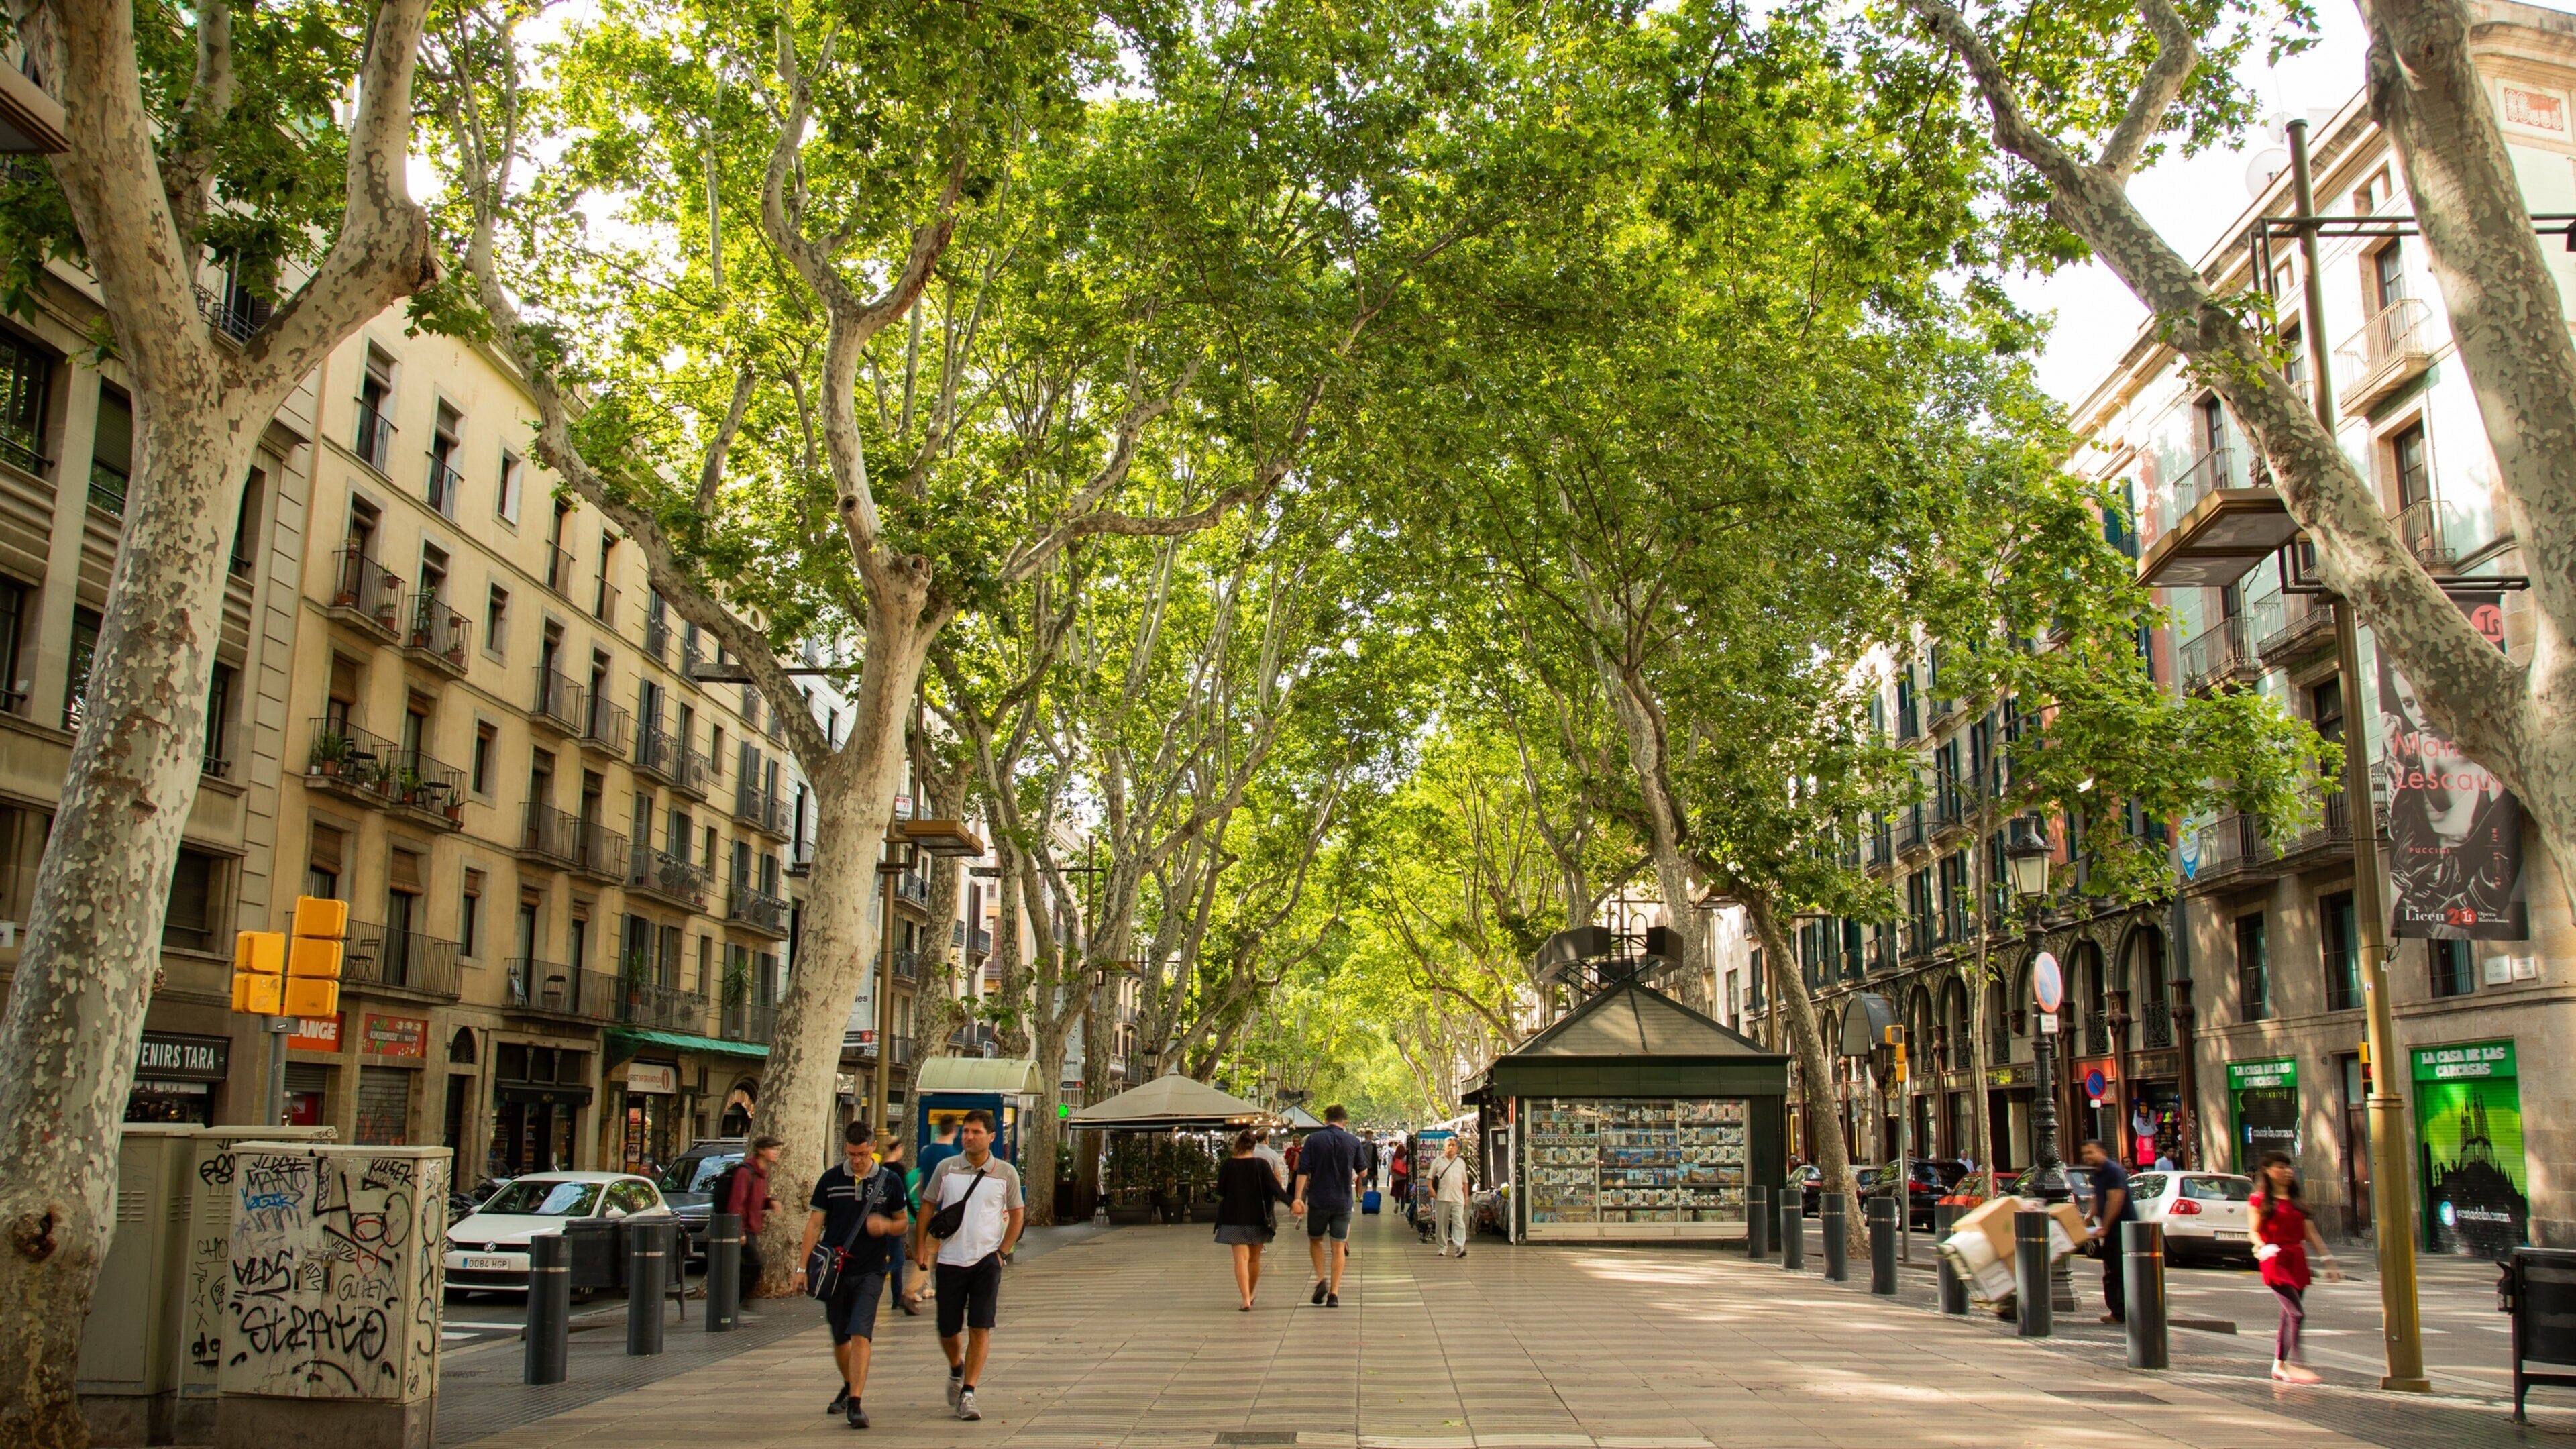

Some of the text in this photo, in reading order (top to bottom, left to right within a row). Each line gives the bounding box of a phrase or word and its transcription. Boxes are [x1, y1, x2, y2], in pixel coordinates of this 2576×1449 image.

[2404, 909, 2446, 922] Liceu
[287, 1020, 338, 1040] ANGE
[184, 1045, 215, 1071] TARA
[2421, 1046, 2506, 1065] LA CASA DE LAS
[2436, 1062, 2491, 1077] CARCASAS
[468, 1259, 508, 1268] 0084 HGP
